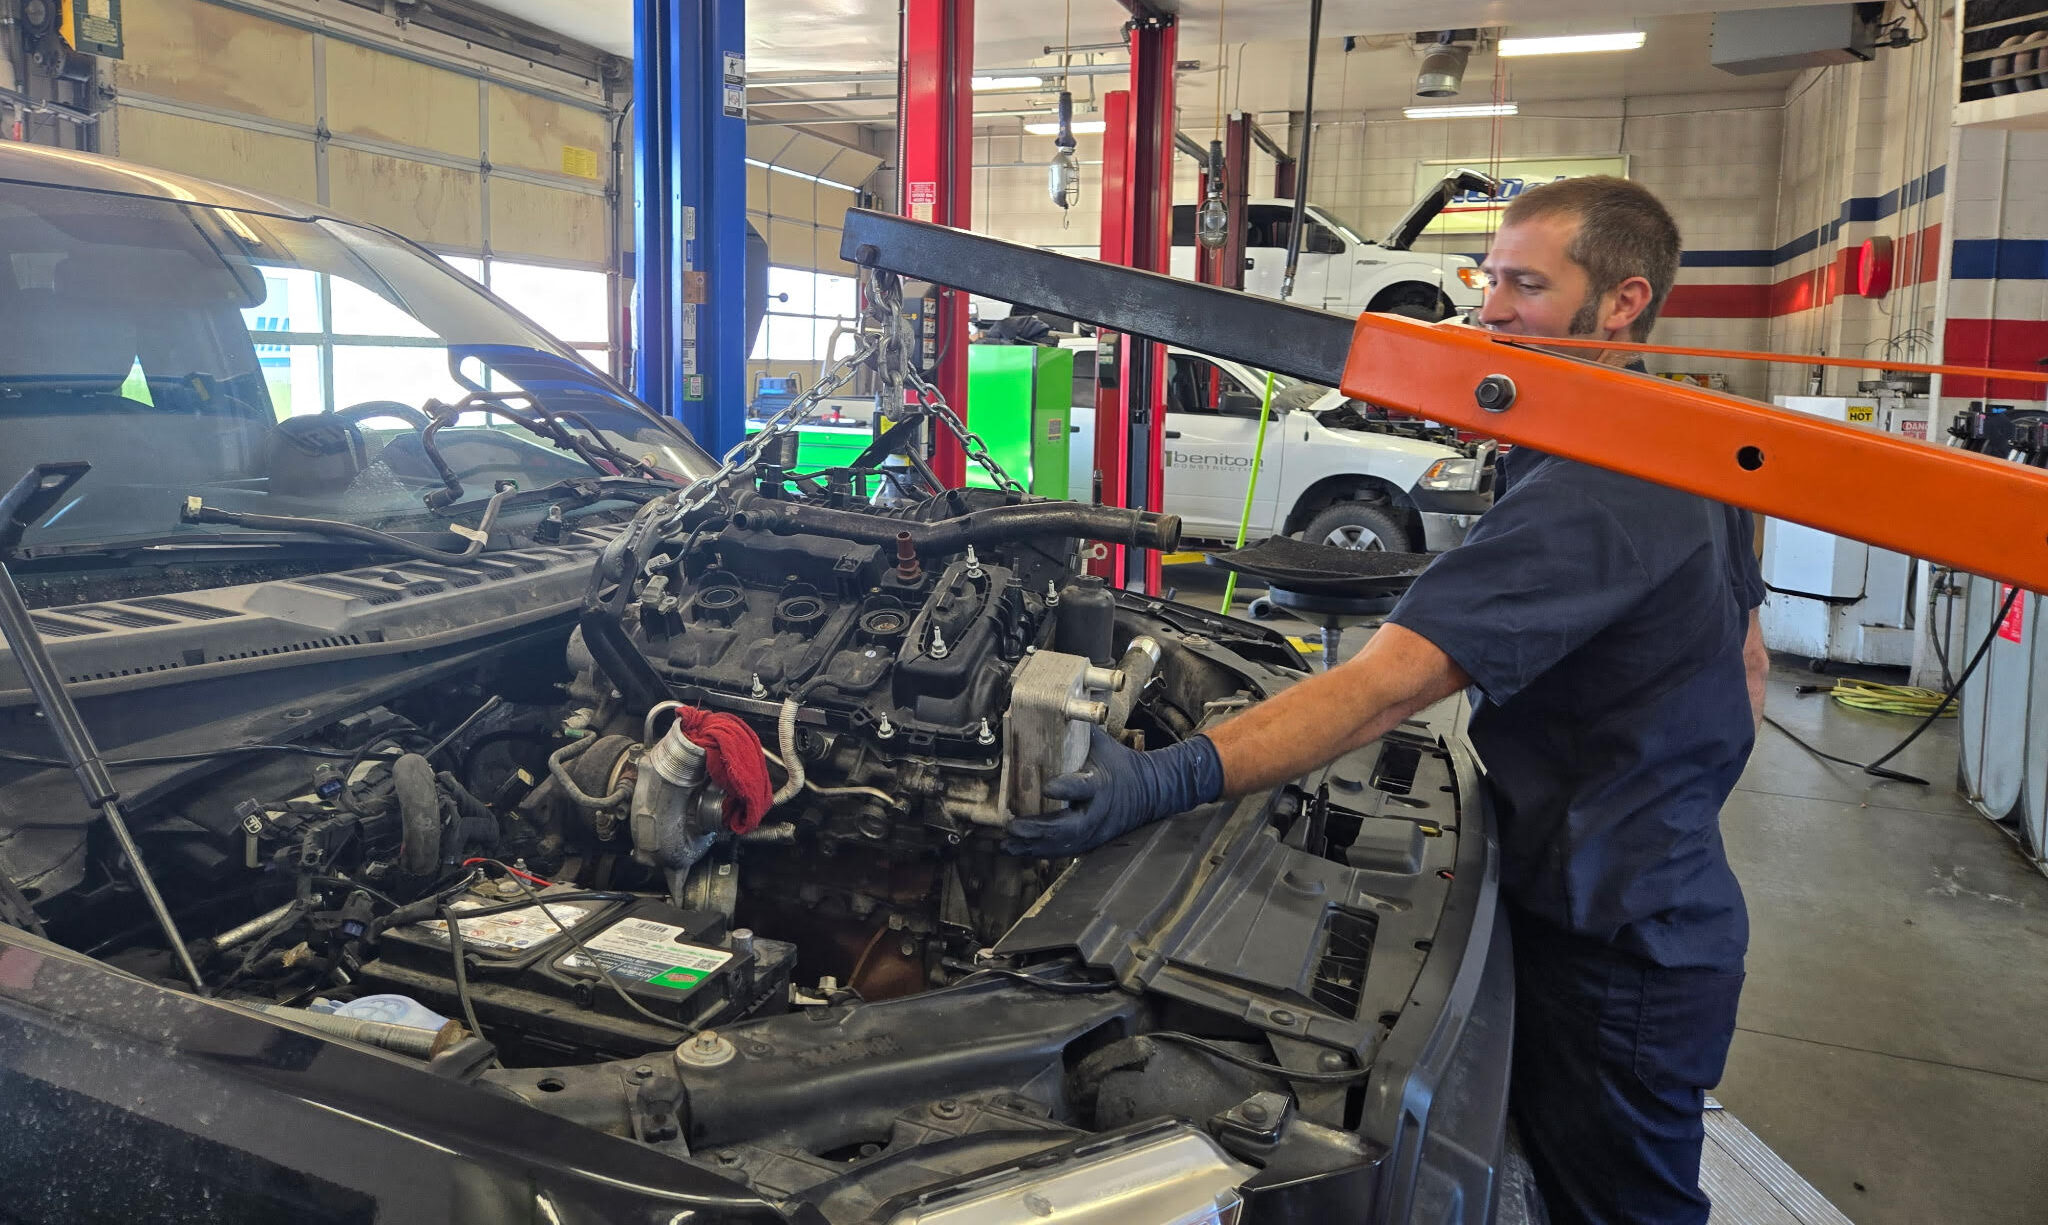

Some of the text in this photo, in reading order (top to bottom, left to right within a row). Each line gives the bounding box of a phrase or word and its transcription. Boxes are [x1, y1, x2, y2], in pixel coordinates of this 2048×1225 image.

[1905, 422, 1928, 430] DAN
[1174, 451, 1264, 467] beniton
[1174, 463, 1264, 472] CONSTRUCTIN
